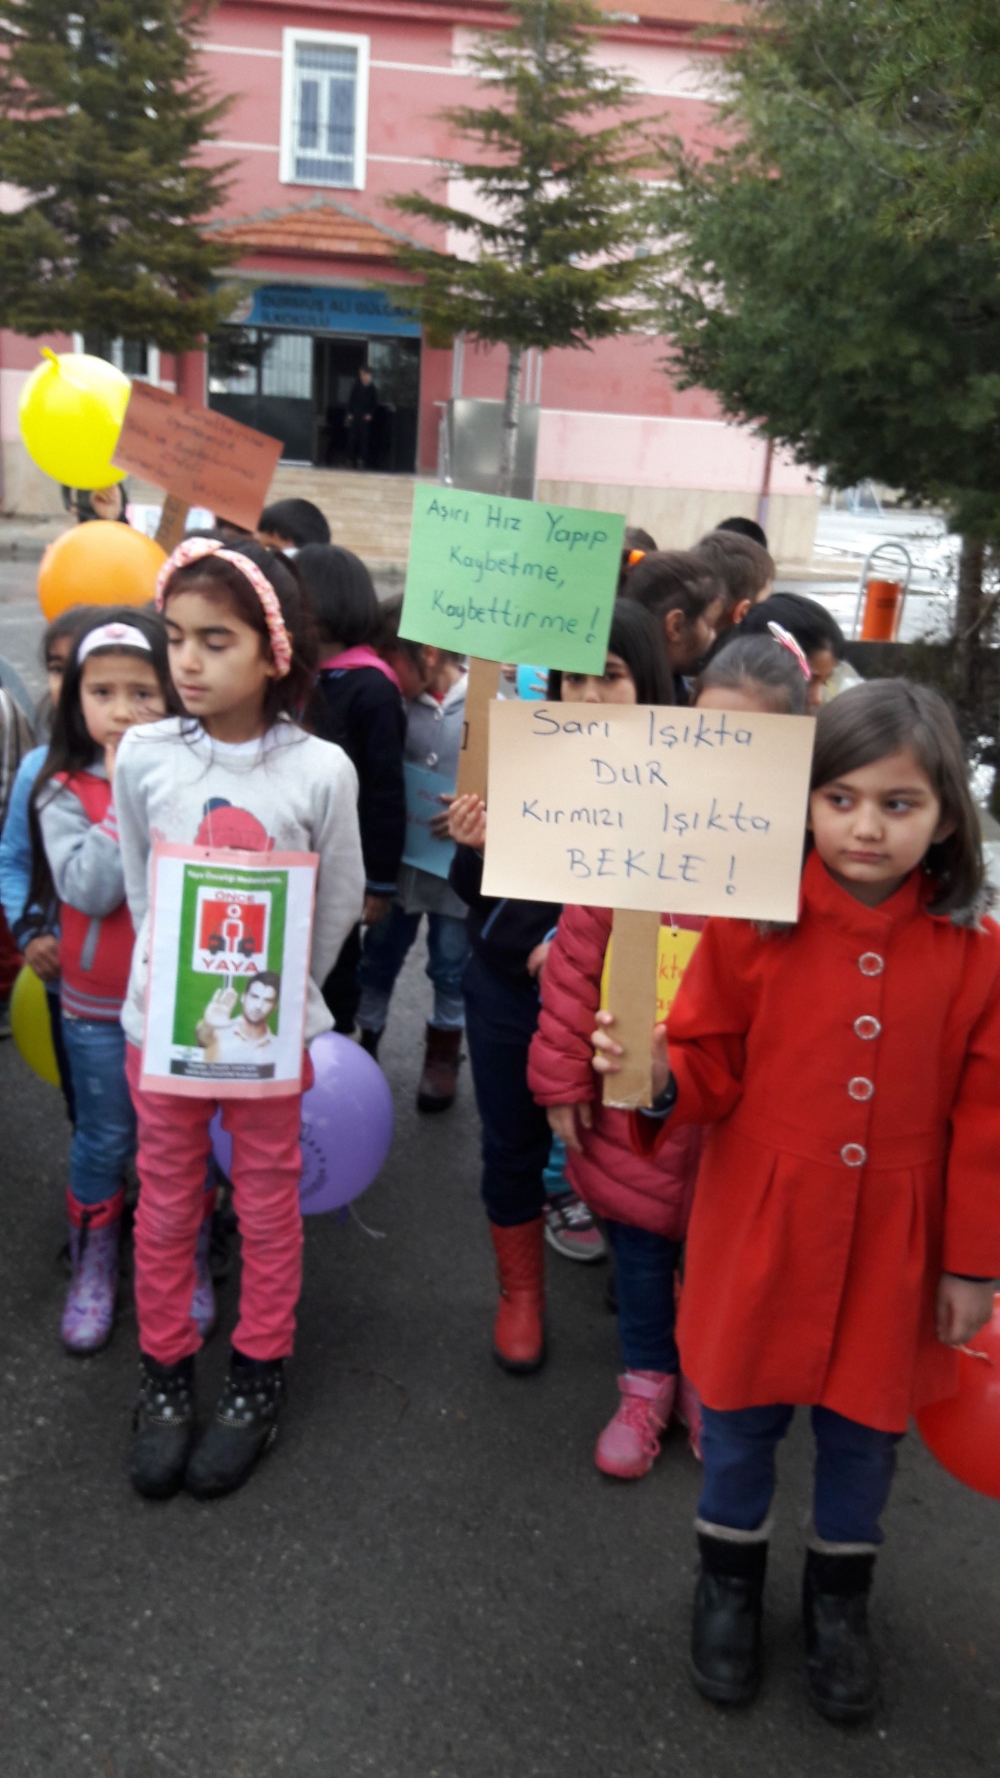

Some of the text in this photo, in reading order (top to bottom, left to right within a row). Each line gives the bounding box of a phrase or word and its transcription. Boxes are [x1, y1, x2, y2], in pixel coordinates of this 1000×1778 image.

[426, 498, 608, 551] Aşırı Hız Yapıp
[449, 545, 565, 589] Kaybetme,
[532, 708, 753, 749] Sarı Işıkta
[590, 758, 669, 787] DUR
[522, 798, 771, 836] Kırmızı Işıkta
[201, 957, 259, 974] YAYA
